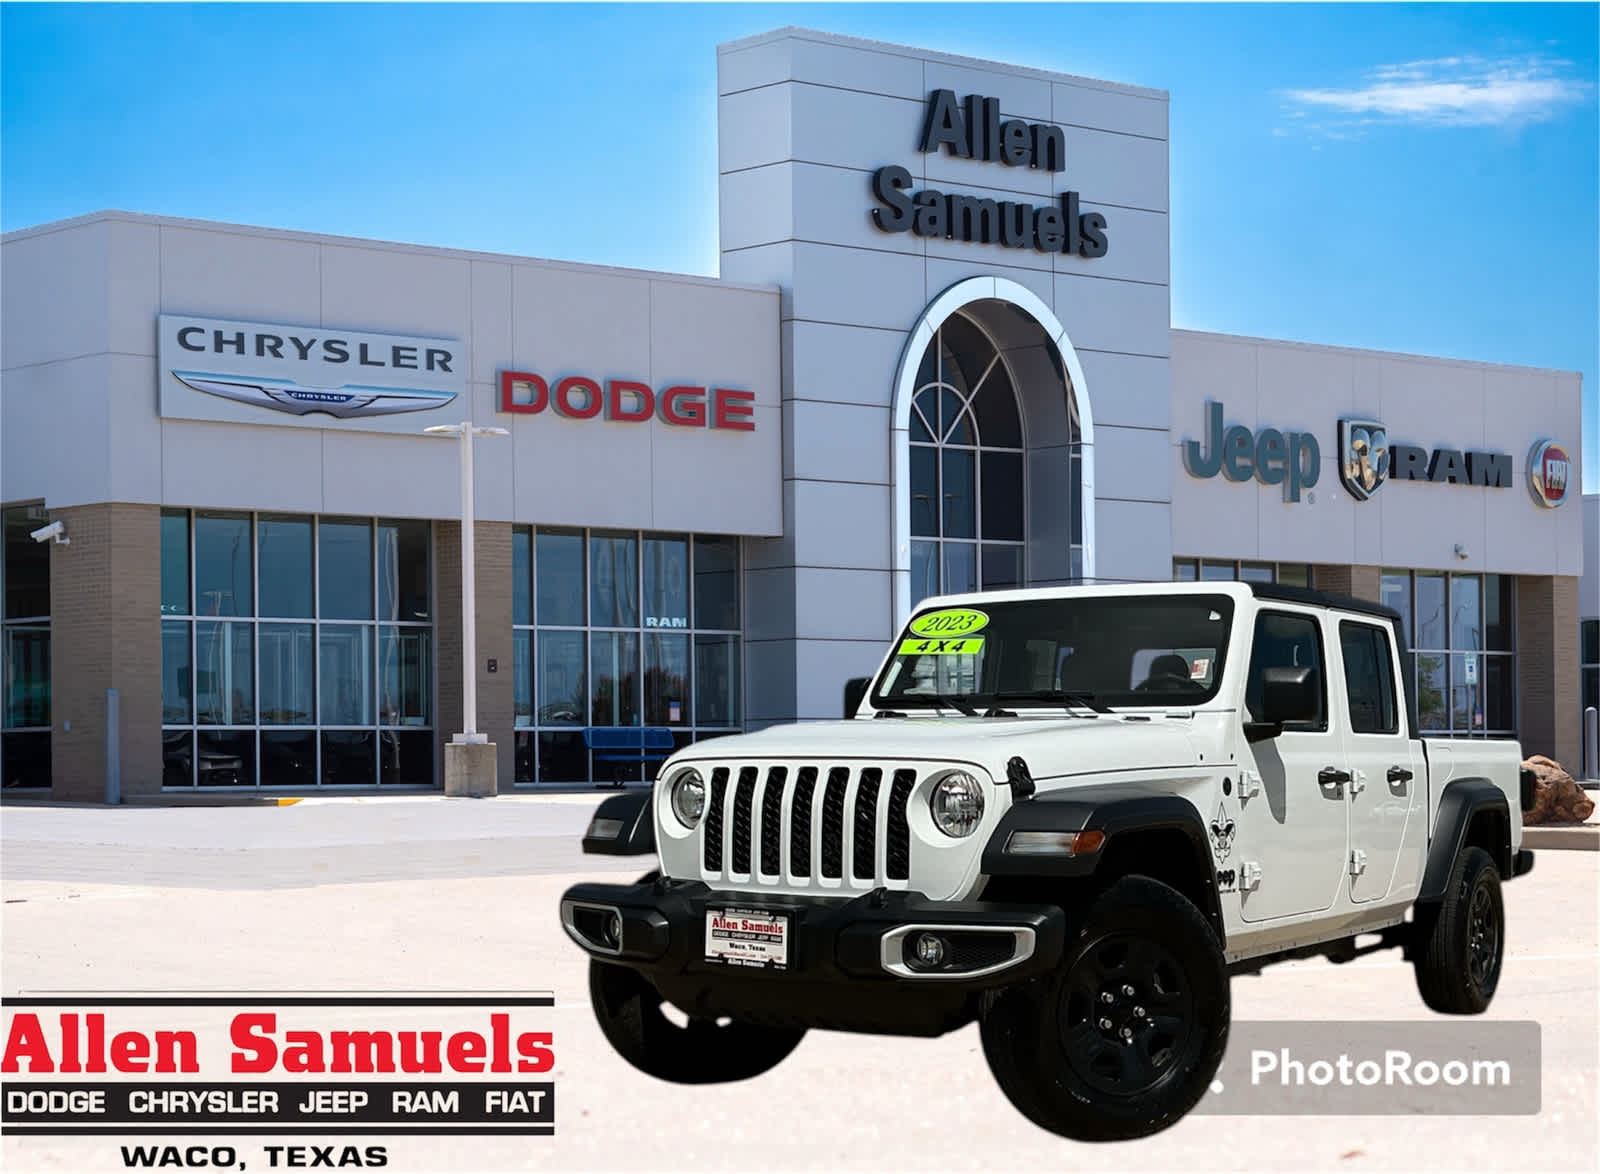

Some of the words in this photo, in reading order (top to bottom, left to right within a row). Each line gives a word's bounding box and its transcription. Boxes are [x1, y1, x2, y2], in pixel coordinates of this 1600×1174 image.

[919, 89, 1066, 173] Allen
[872, 165, 1108, 258] Samuels
[177, 327, 454, 372] CHRYSLER
[291, 392, 347, 401] CHRYSLER
[497, 370, 756, 432] DODGE
[1182, 400, 1321, 503] Jeep
[1389, 445, 1513, 489] RAM
[646, 616, 687, 628] RAM
[921, 615, 978, 632] 2023
[712, 917, 738, 930] Allen
[742, 919, 784, 934] Samuels
